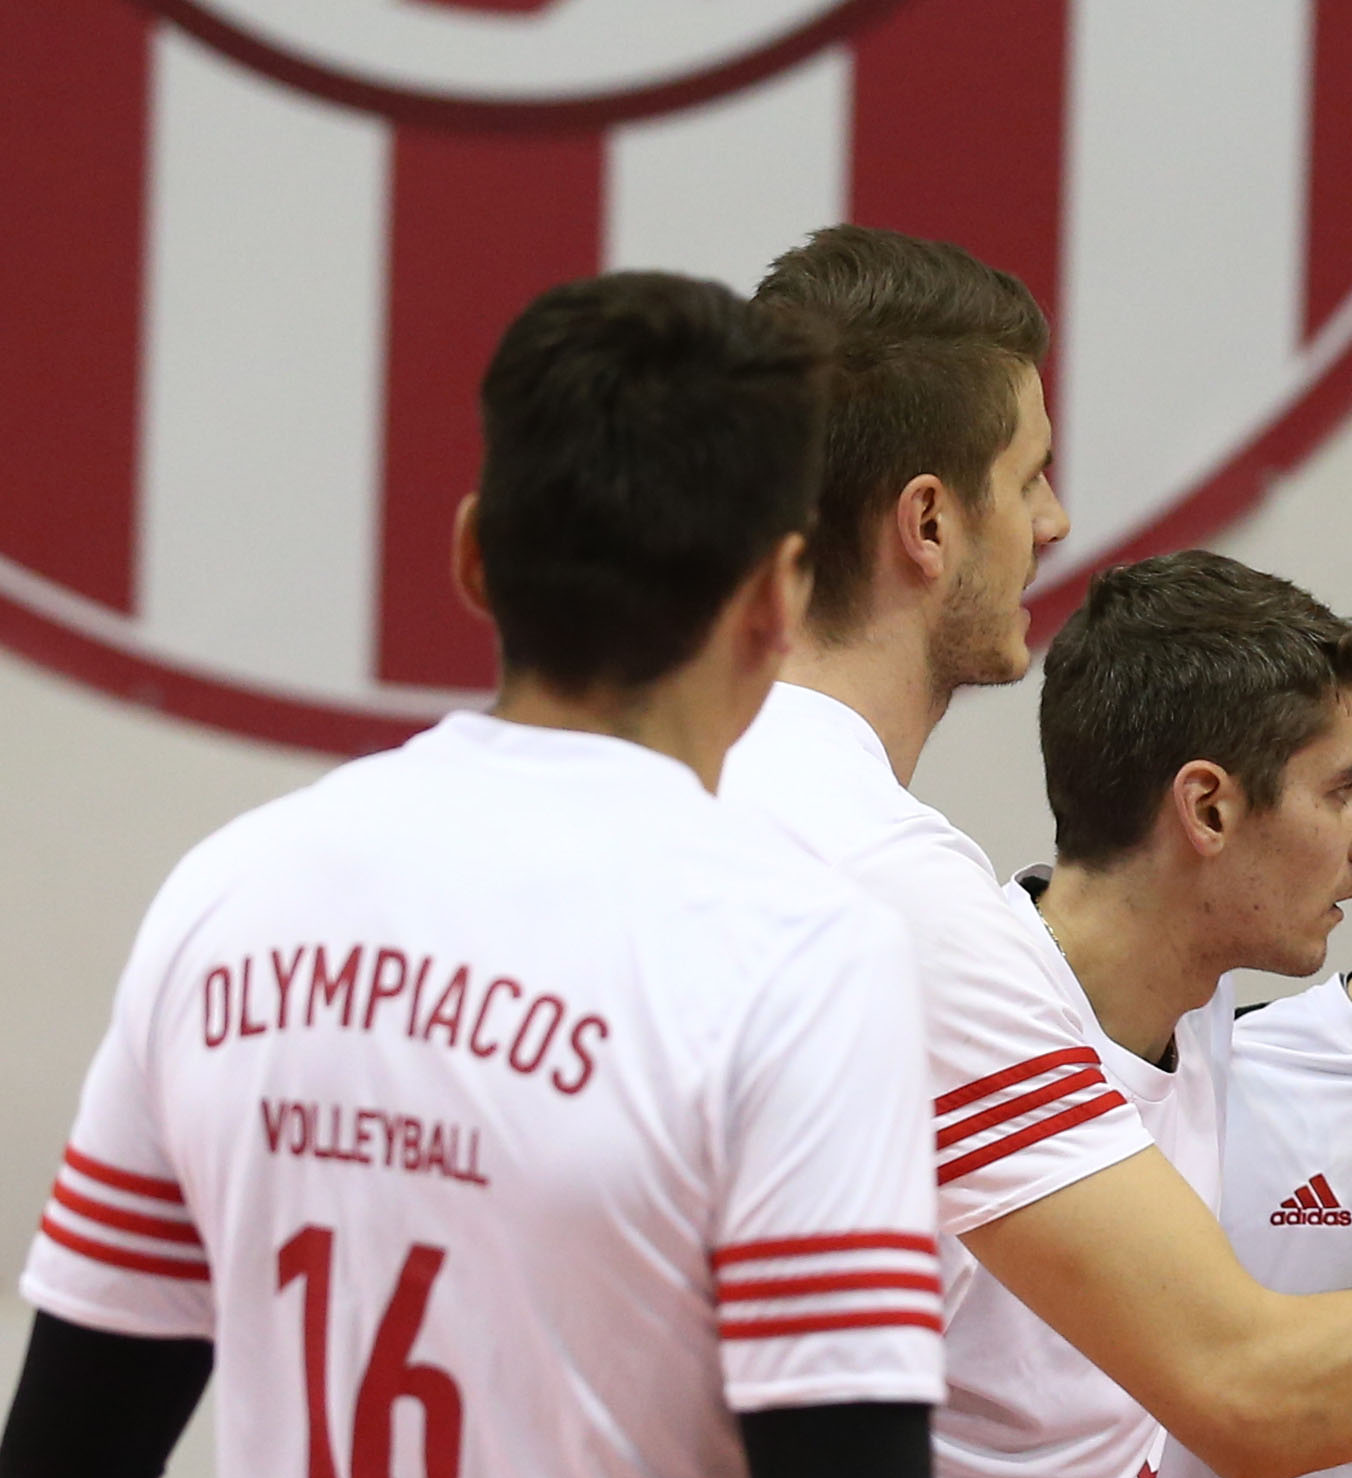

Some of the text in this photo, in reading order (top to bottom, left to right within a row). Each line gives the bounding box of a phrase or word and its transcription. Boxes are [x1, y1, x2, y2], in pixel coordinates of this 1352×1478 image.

[203, 943, 609, 1096] OLYMPIACOS
[261, 1097, 489, 1187] VOLLEYBALL
[1270, 1207, 1352, 1226] adidas
